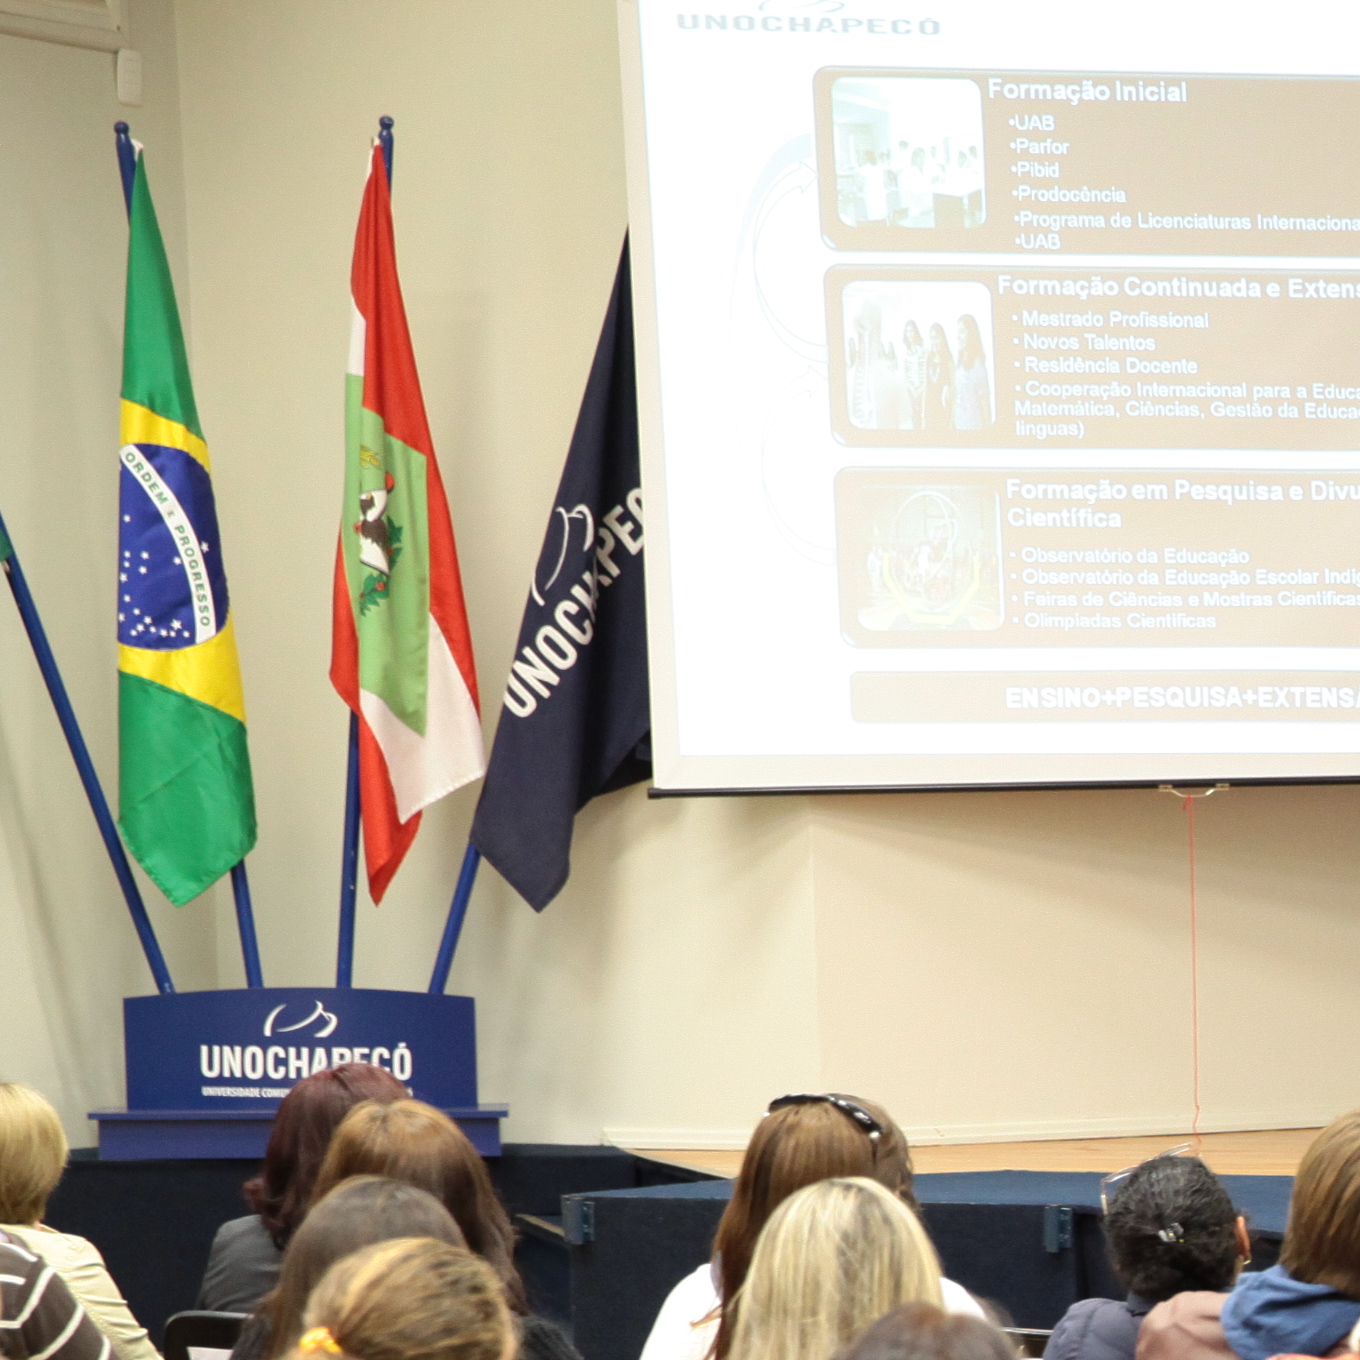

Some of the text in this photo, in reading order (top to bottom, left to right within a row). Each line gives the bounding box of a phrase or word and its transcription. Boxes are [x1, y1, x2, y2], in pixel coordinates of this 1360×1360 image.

[989, 78, 1187, 105] Formação Inicial
[1016, 138, 1070, 154] Parfor
[1017, 161, 1059, 177] Pibid
[1018, 185, 1126, 203] Prodocência
[1020, 210, 1105, 231] Programa
[1110, 212, 1132, 228] de
[1138, 212, 1252, 230] Licenciaturas
[998, 274, 1119, 300] Formação
[1124, 276, 1262, 298] Continuada
[1266, 282, 1280, 298] e
[1022, 310, 1209, 328] Mestrado Profissional
[1024, 333, 1156, 351] Novos Talentos
[1025, 356, 1198, 374] Residência Docente
[1025, 380, 1132, 400] Cooperação
[1137, 382, 1247, 398] Internacional
[1253, 386, 1291, 401] para
[1296, 386, 1307, 398] a
[1015, 400, 1120, 418] Matemática,
[1125, 400, 1204, 418] Ciências,
[1210, 401, 1272, 417] Gestão
[1278, 402, 1298, 418] da
[1006, 478, 1128, 504] Formação
[1131, 484, 1168, 500] em
[1175, 479, 1284, 505] Pesquisa
[1289, 485, 1303, 500] e
[125, 452, 169, 504] ORDEM
[174, 525, 210, 626] PROGRESSO
[1021, 547, 1250, 567] Observatório da Educação
[1022, 568, 1134, 585] Observatório
[1137, 570, 1159, 585] da
[1165, 568, 1251, 588] Educação
[1255, 569, 1320, 585] Escolar
[1023, 590, 1078, 606] Feiras
[1082, 591, 1104, 606] de
[1109, 591, 1183, 606] Ciências
[1188, 595, 1199, 606] e
[1203, 592, 1273, 606] Mostras
